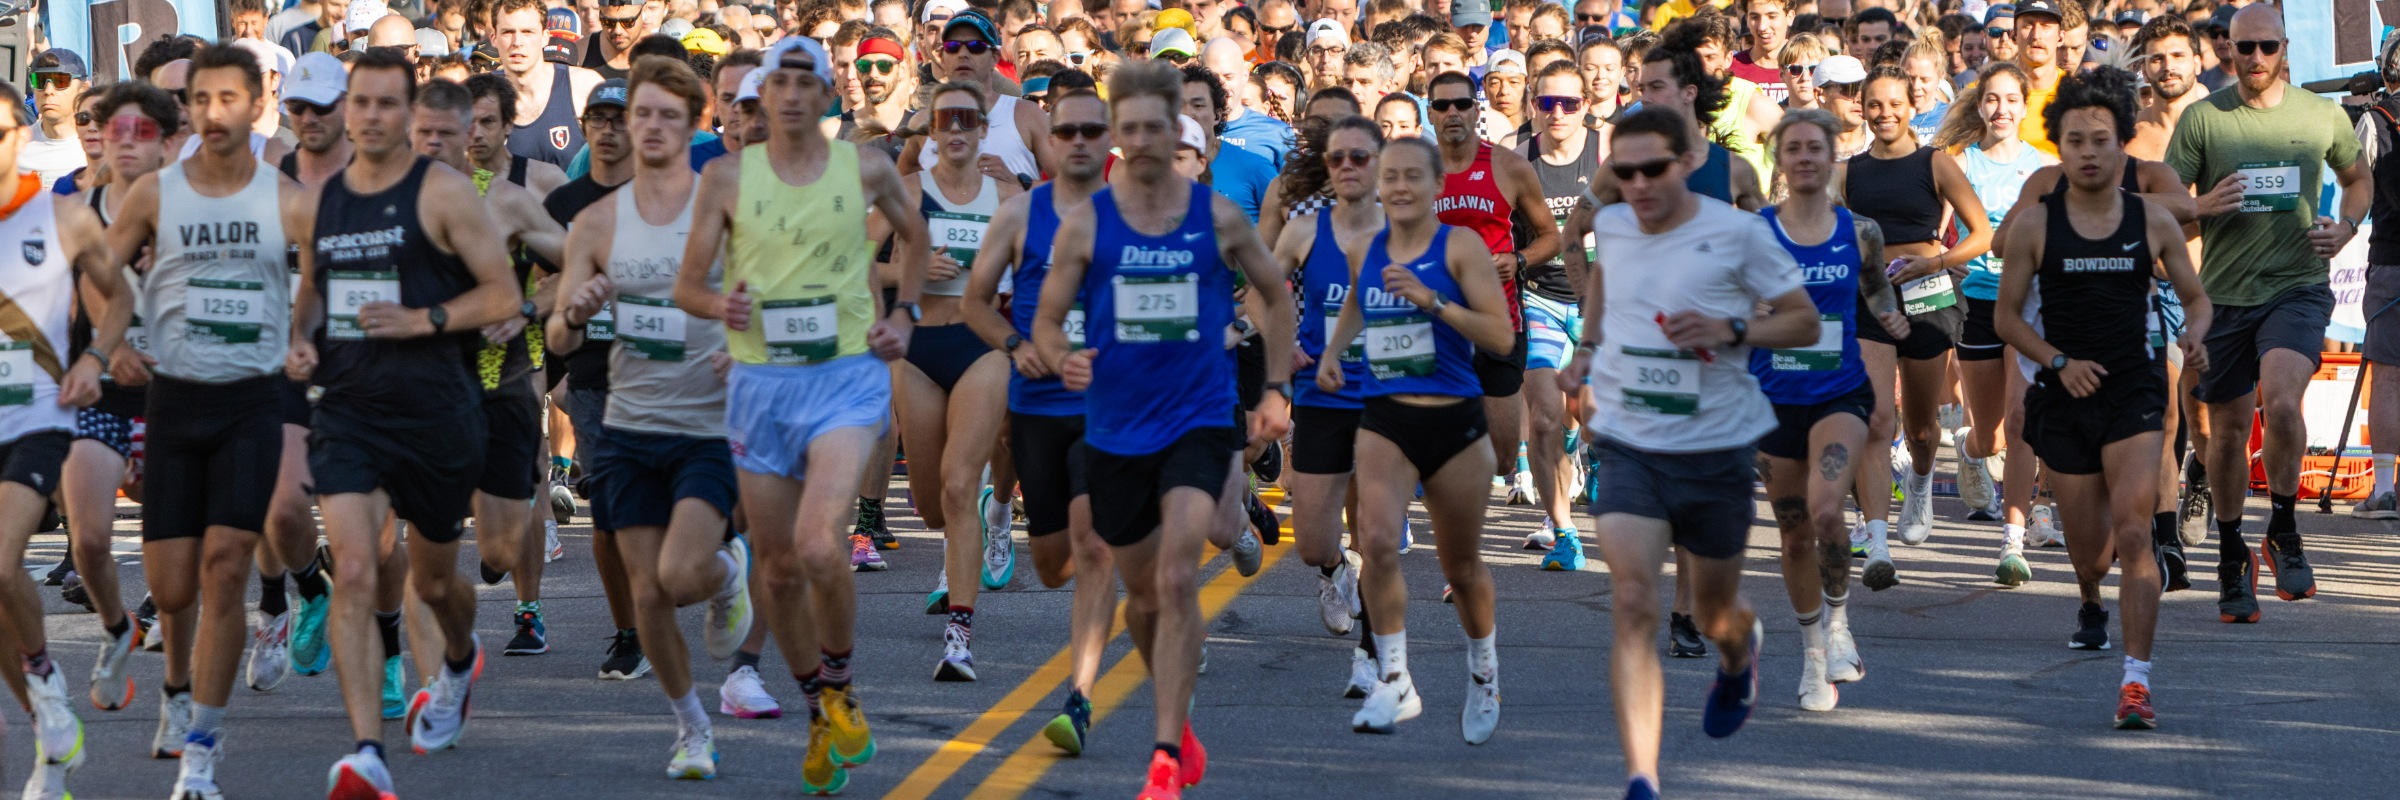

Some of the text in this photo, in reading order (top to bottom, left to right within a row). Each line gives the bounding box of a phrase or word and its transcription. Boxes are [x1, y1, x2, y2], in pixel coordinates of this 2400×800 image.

[2255, 175, 2285, 189] 559
[1433, 195, 1494, 214] HIRLAWAY
[1980, 184, 2018, 208] US
[179, 221, 261, 246] VALOR
[947, 228, 979, 242] 823
[1117, 246, 1194, 270] Dirigo
[2063, 257, 2135, 271] BOWDOIN
[1800, 261, 1849, 285] irigo
[1918, 275, 1943, 291] 451
[203, 298, 250, 316] 1259
[1138, 294, 1177, 311] 275
[633, 315, 665, 332] 541
[785, 317, 819, 333] 816
[587, 331, 615, 340] Outside
[1382, 334, 1413, 352] 210
[1772, 362, 1811, 370] Outsider
[1638, 367, 1681, 386] 300
